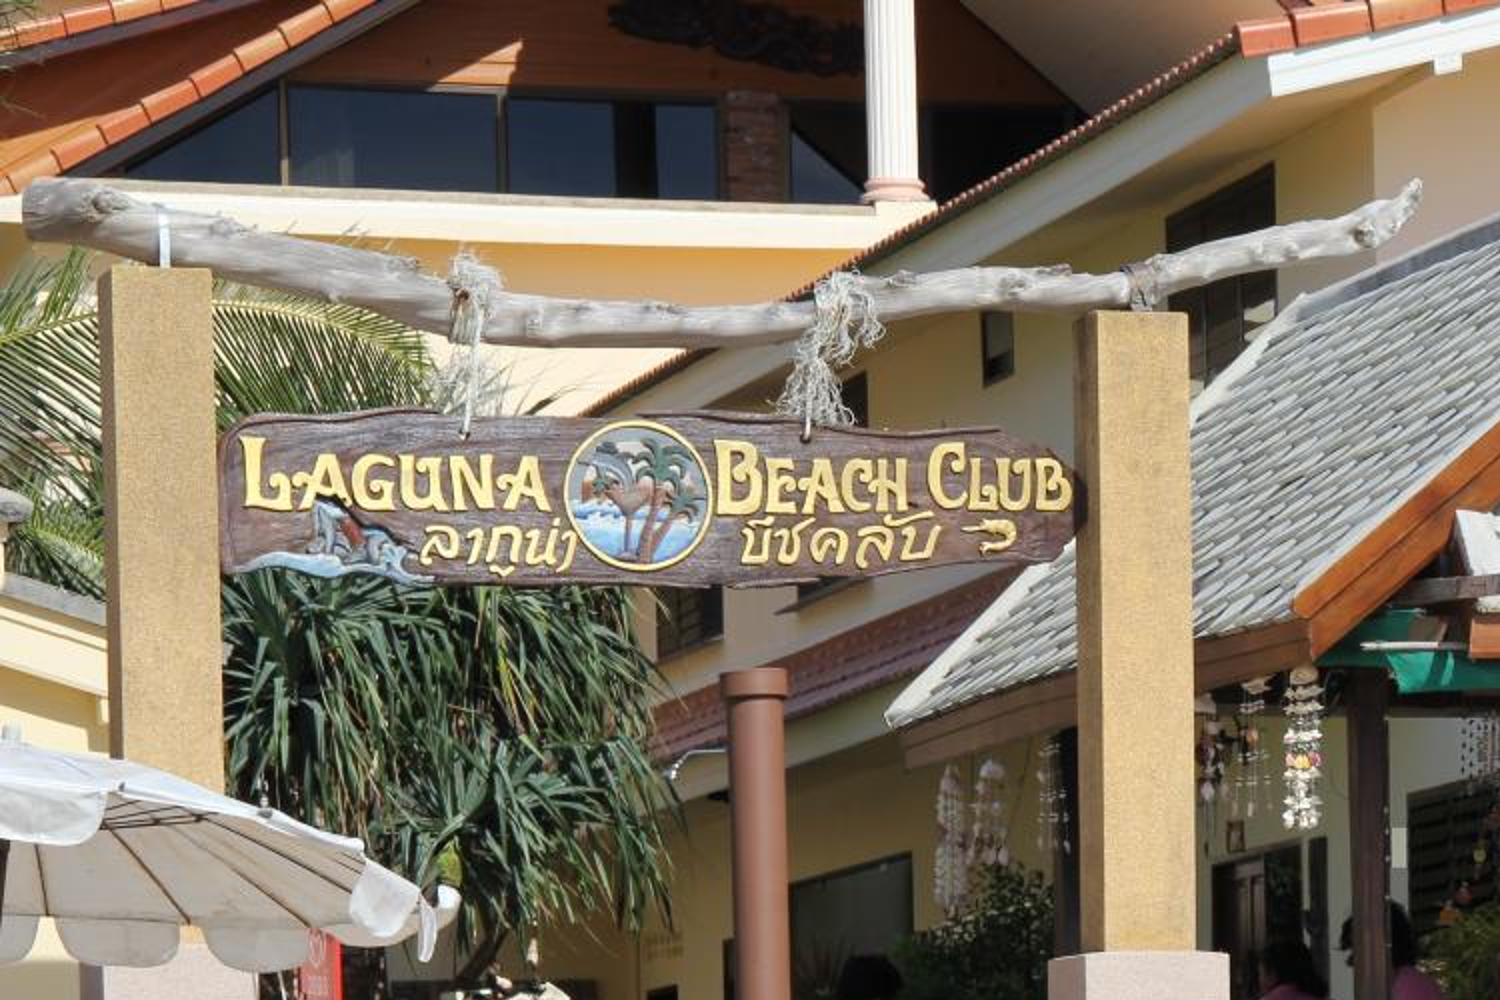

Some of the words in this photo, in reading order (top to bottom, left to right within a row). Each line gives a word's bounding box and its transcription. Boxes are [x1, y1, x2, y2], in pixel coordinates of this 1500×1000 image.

[240, 435, 552, 512] LAGUNA
[714, 439, 909, 515] BEACH
[928, 442, 1073, 512] CLUB
